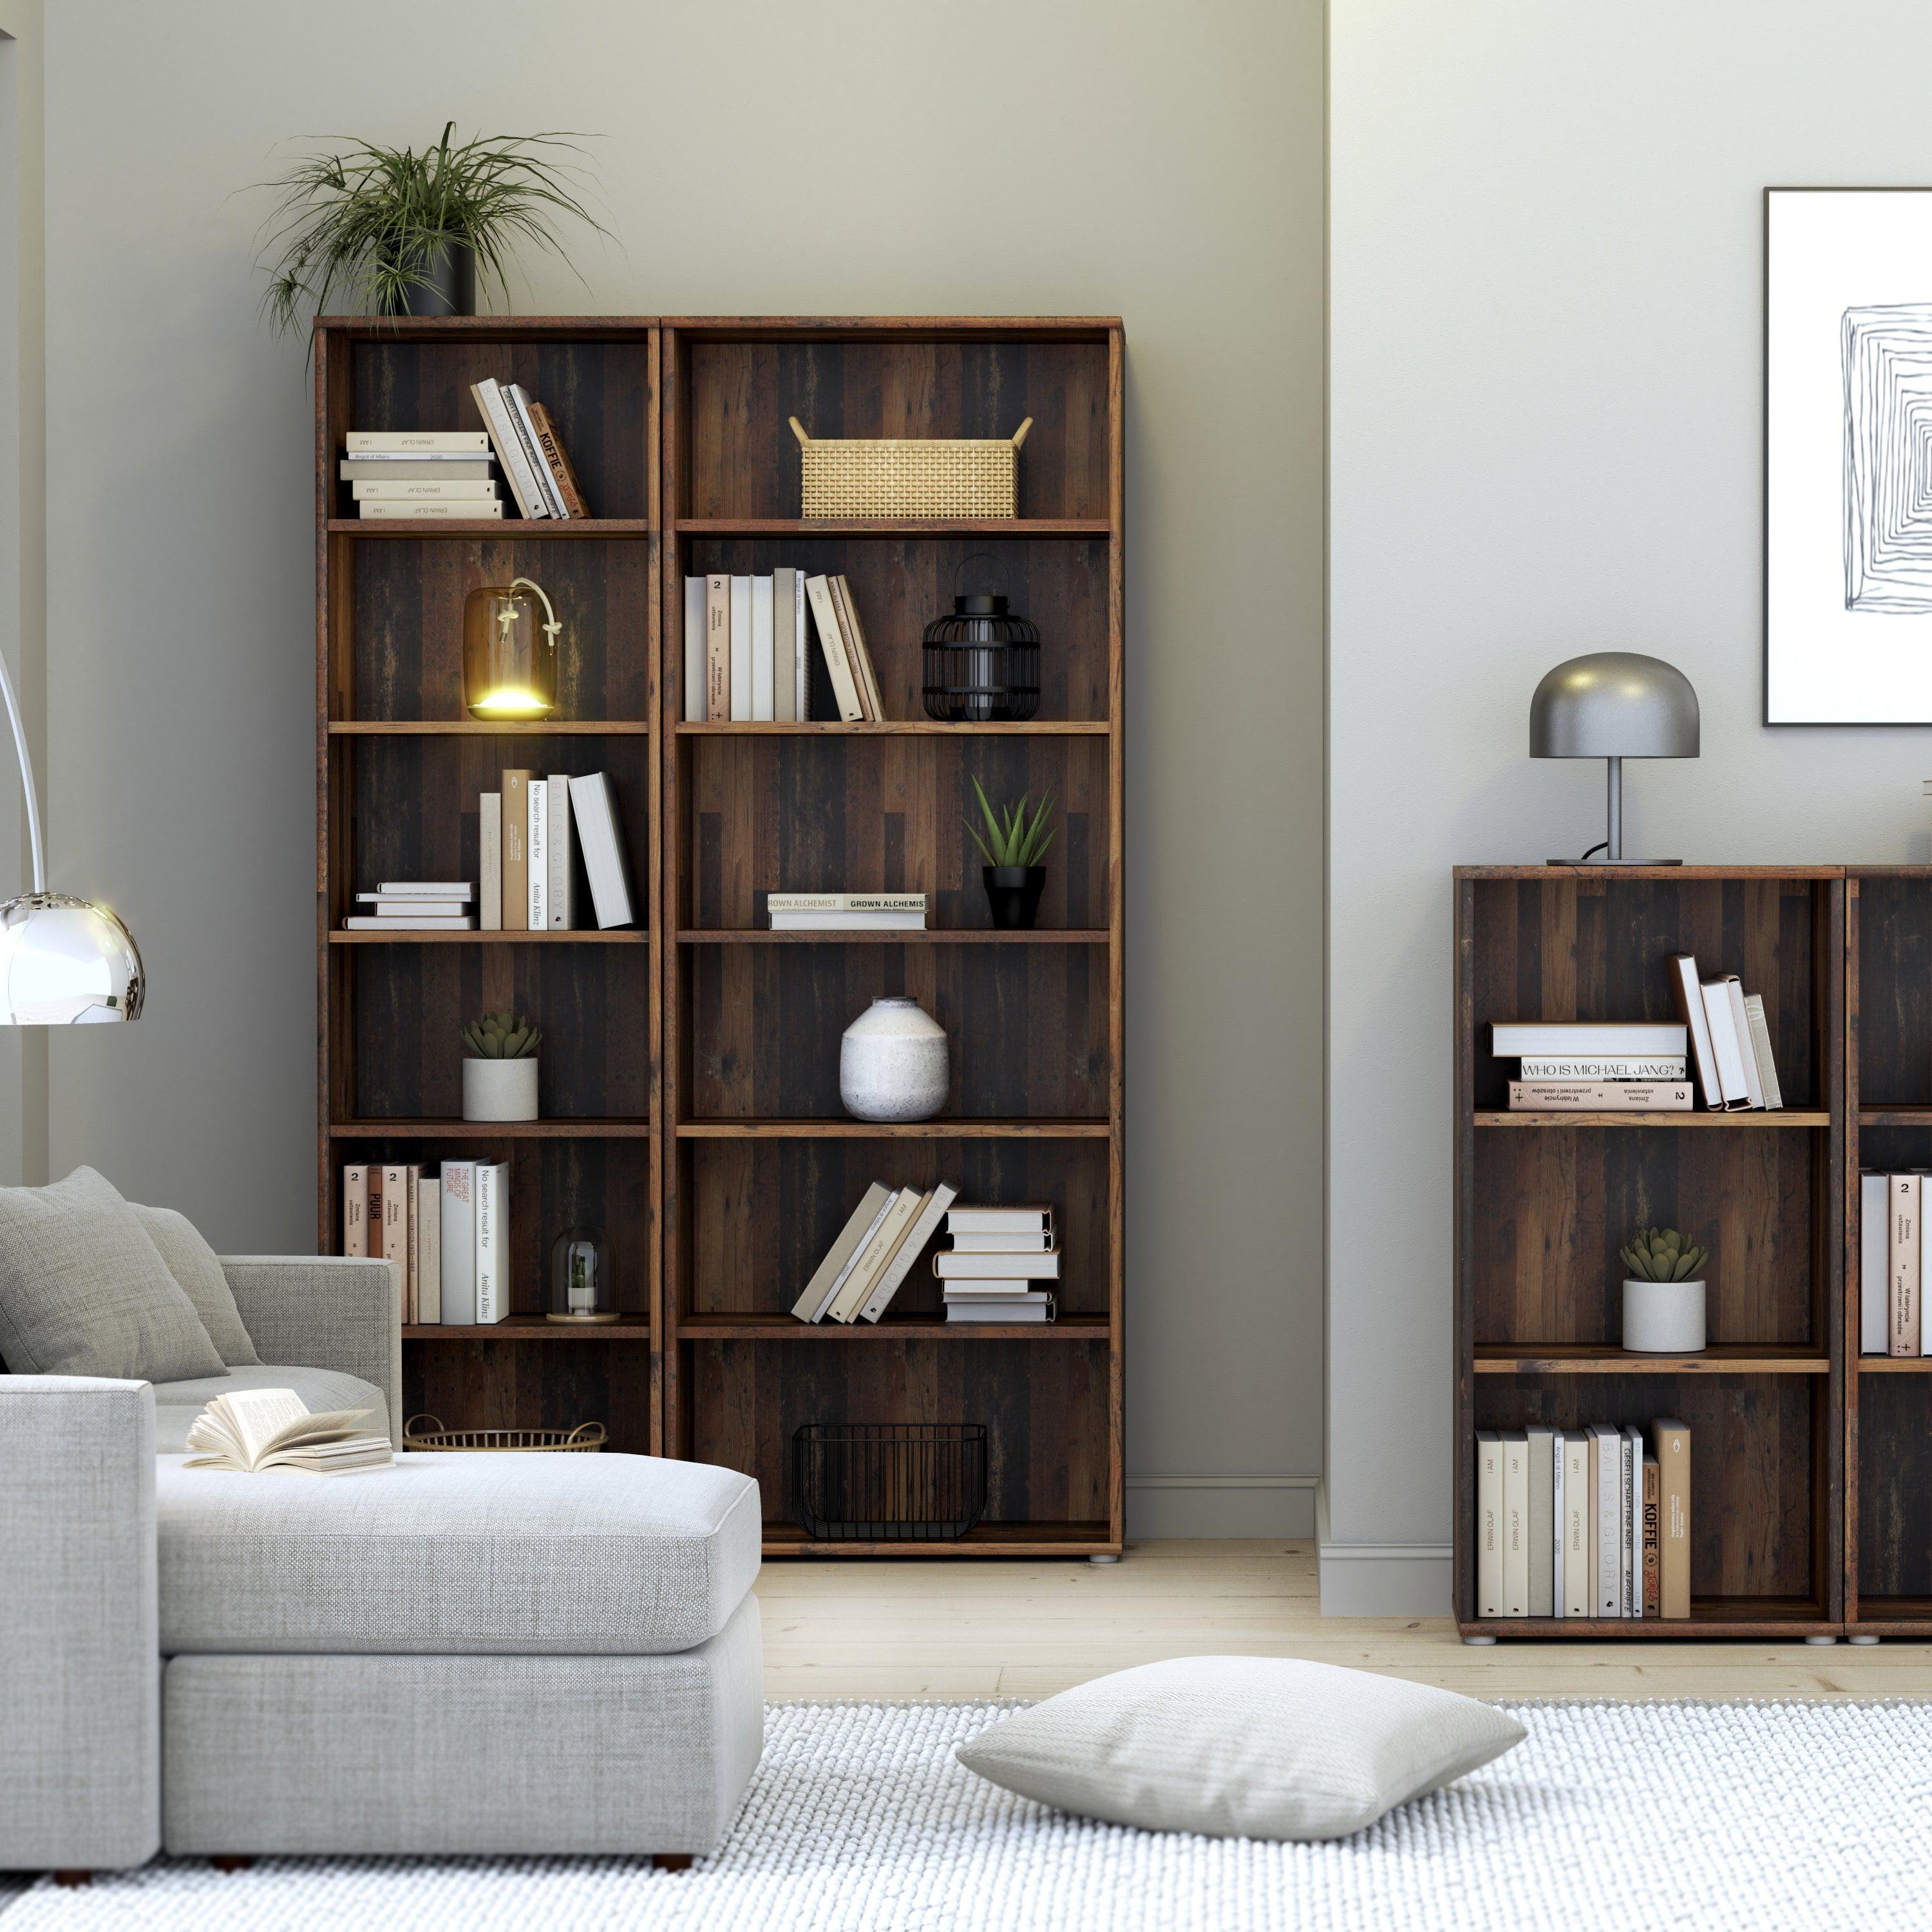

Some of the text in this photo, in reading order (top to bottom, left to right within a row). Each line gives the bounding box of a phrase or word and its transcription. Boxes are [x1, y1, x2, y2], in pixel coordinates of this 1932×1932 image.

[540, 432, 562, 469] KOFFIE
[559, 484, 578, 507] STORIES
[815, 591, 823, 600] AM
[826, 632, 835, 647] OLAF
[533, 784, 541, 795] No
[1522, 1065, 1674, 1075] WHO IS MICHAEL JANG?
[1675, 1092, 1685, 1100] 2
[351, 1173, 359, 1181] 2
[482, 1170, 489, 1182] No
[454, 1190, 460, 1198] OF
[1900, 1184, 1909, 1193] 2
[370, 1193, 381, 1220] PUUR
[898, 1204, 907, 1214] AM
[863, 1240, 885, 1272] ERWIN OLAF
[481, 1298, 489, 1319] Klinz
[1488, 1459, 1493, 1470] AM
[1513, 1459, 1519, 1470] AM
[1573, 1459, 1579, 1470] AM
[1645, 1504, 1657, 1549] KOFFIE
[1604, 1527, 1616, 1593] GLORY
[1643, 1570, 1659, 1602] STORIES
